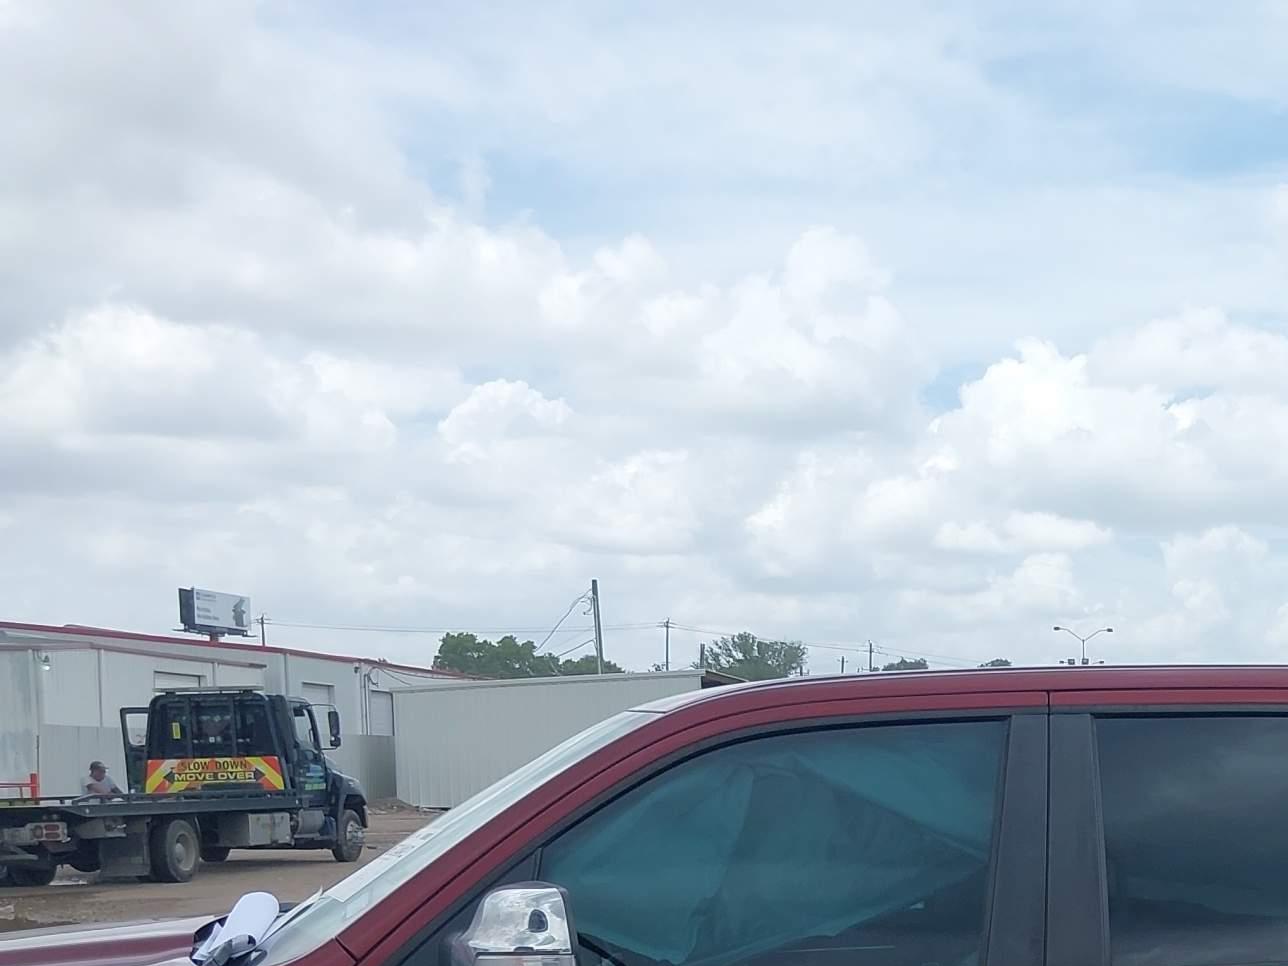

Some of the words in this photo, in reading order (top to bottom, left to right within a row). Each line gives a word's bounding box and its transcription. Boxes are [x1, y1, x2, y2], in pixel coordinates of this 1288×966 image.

[179, 760, 210, 772] SLOW
[215, 759, 247, 770] DOWN
[175, 772, 214, 782] MOVE
[218, 771, 255, 780] OVER
